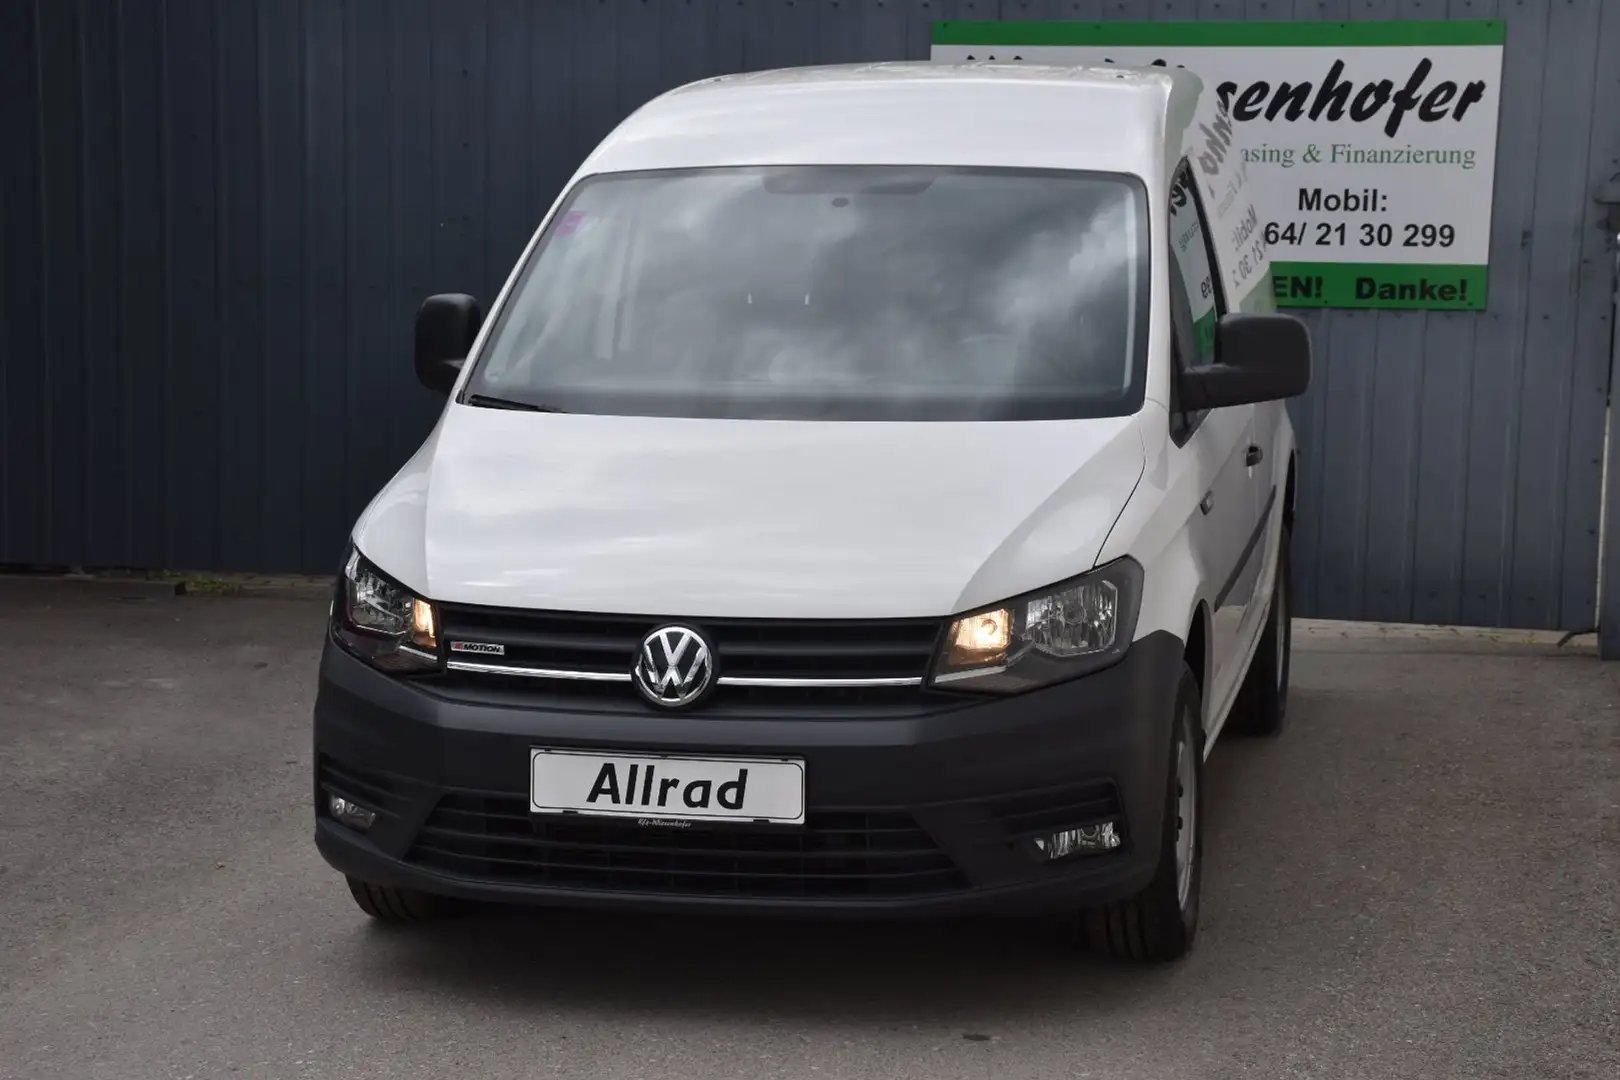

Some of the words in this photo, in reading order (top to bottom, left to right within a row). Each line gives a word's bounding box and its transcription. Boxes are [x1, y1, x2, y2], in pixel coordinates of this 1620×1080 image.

[1302, 143, 1322, 163] &
[1330, 143, 1476, 170] Finanzierung
[1298, 188, 1388, 212] Mobil:
[1315, 222, 1346, 246] 21
[1359, 223, 1393, 247] 30
[1402, 223, 1456, 248] 299
[1355, 277, 1468, 301] Danke!
[586, 762, 749, 811] Allrad
